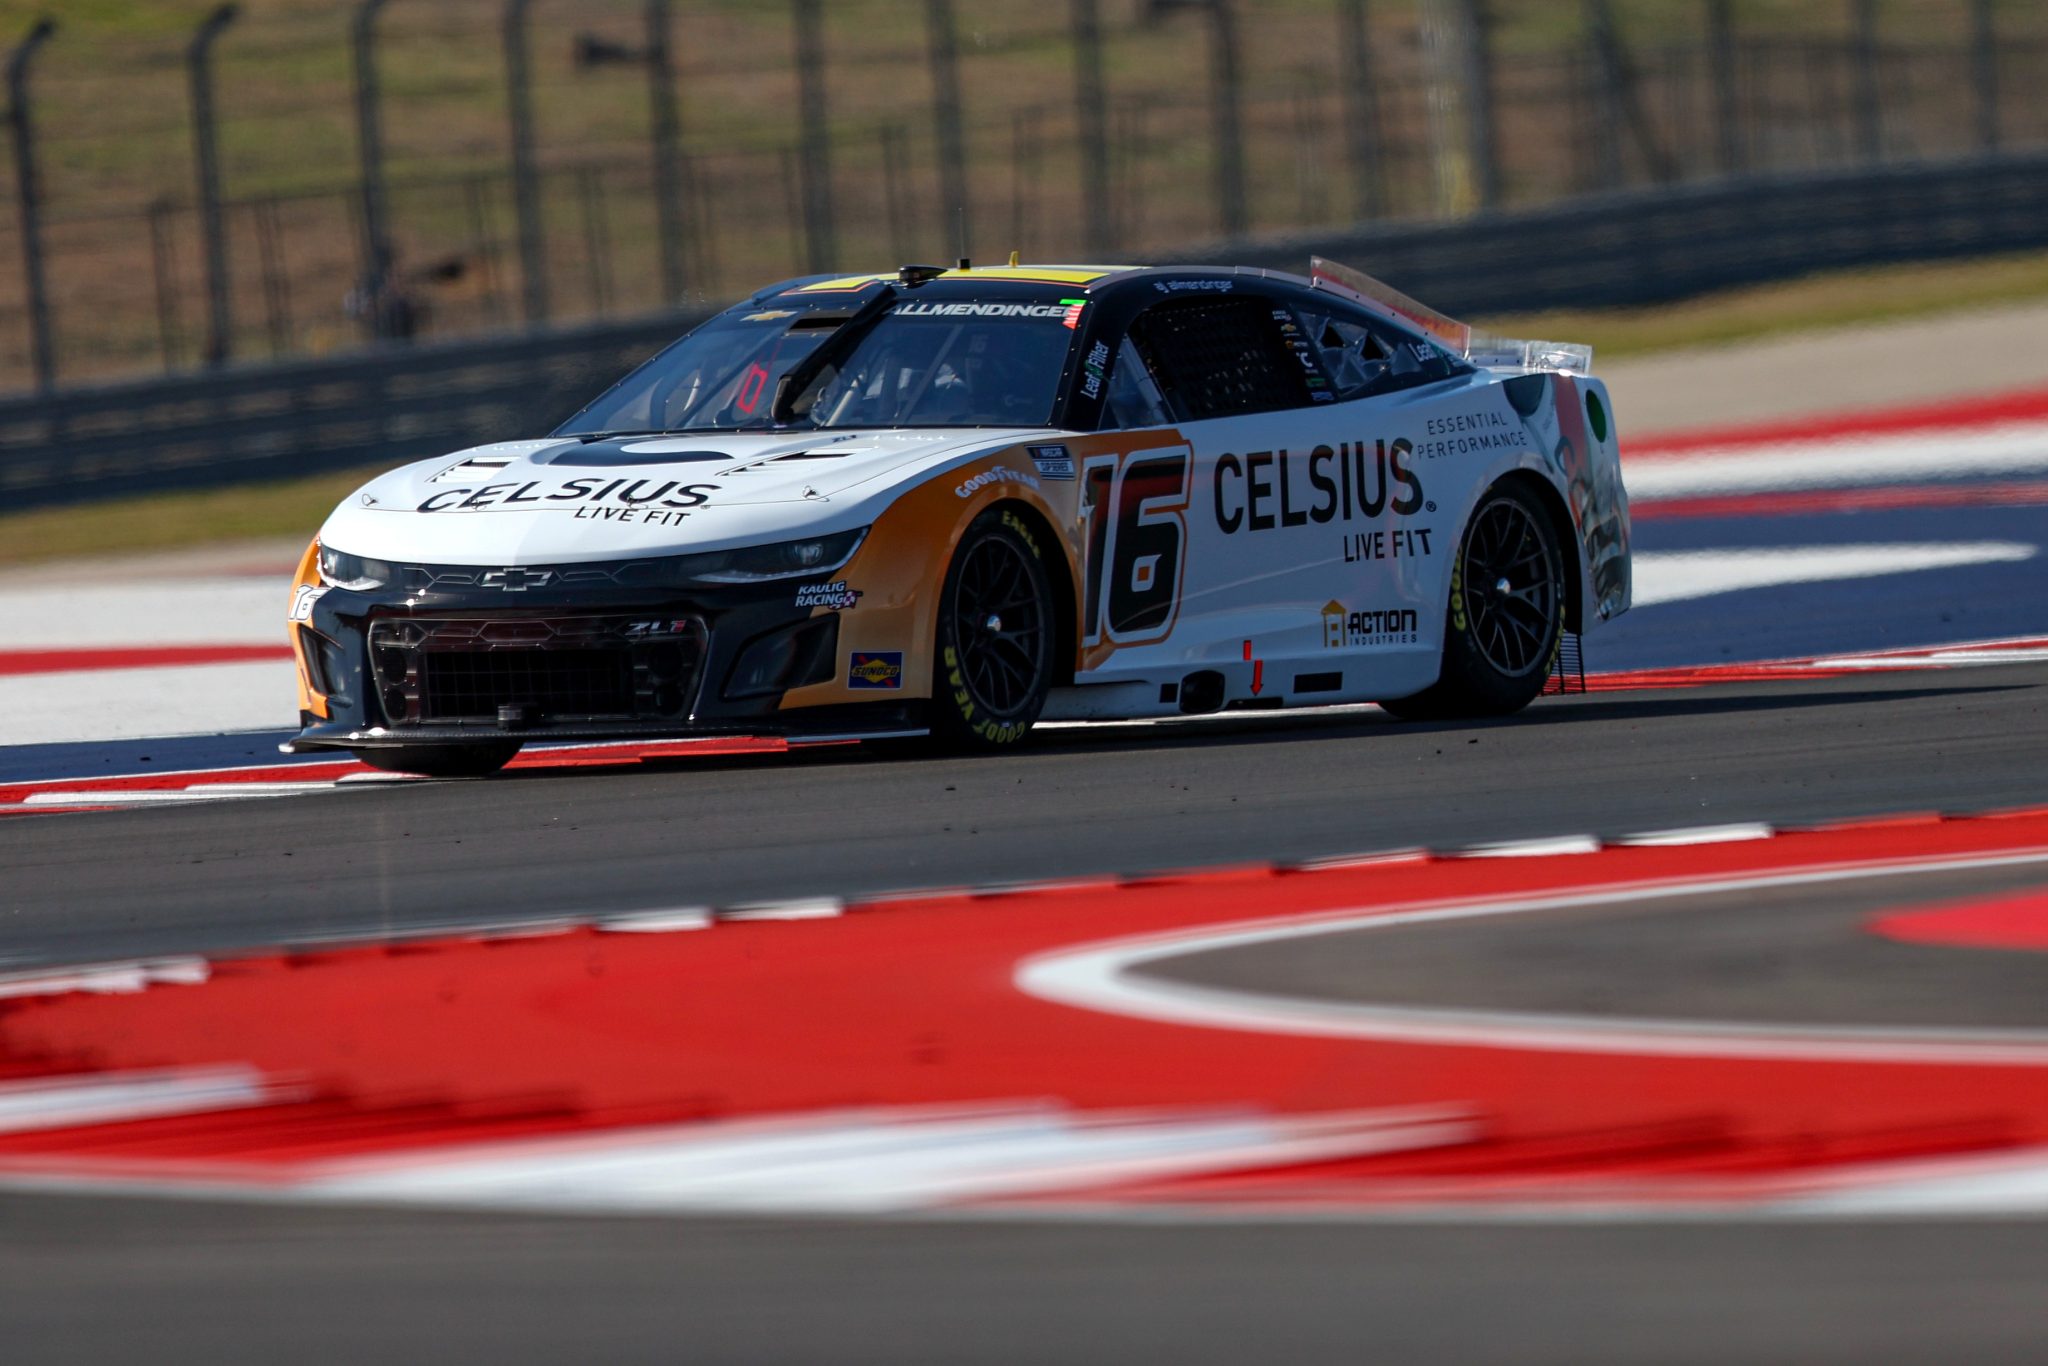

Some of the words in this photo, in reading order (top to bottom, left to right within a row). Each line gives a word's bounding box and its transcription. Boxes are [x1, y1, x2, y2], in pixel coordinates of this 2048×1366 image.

[1087, 339, 1110, 370] Filter
[1080, 371, 1102, 400] Leaf
[1426, 411, 1509, 436] ESSENTIAL
[1416, 431, 1529, 460] PERFORMANCE
[416, 477, 723, 514] CELSIUS
[954, 465, 1041, 499] GOODYEAR
[1214, 437, 1425, 535] CELSIUS
[573, 505, 639, 523] LIVE
[642, 510, 691, 527] FIT
[1080, 444, 1191, 647] 16
[1343, 532, 1385, 563] LIVE
[1392, 528, 1432, 559] FIT
[289, 585, 331, 621] 16
[795, 592, 846, 608] RACING
[797, 581, 847, 597] KAULIG
[624, 619, 688, 636] ZL1
[1347, 609, 1418, 636] ACTION
[1350, 634, 1418, 647] INDUSTRIES
[852, 665, 900, 678] SUNOCO
